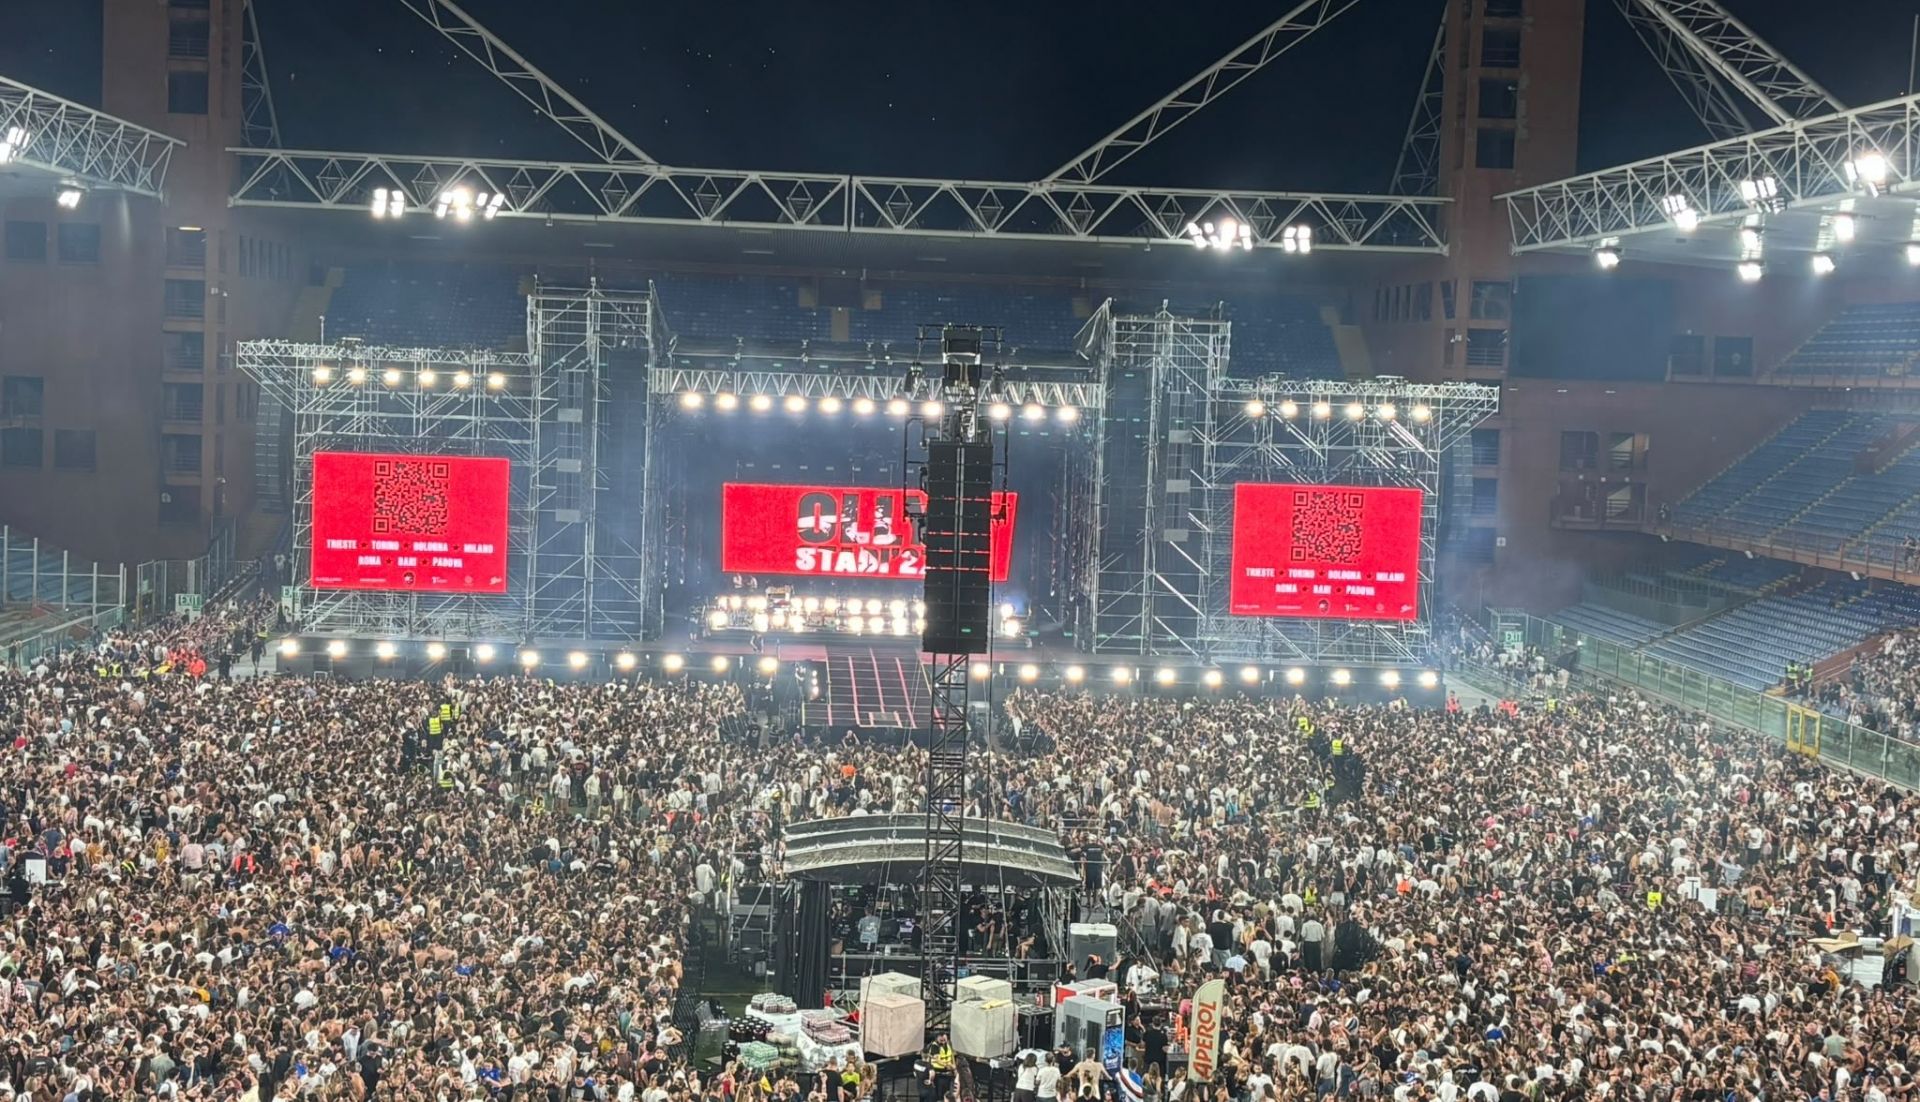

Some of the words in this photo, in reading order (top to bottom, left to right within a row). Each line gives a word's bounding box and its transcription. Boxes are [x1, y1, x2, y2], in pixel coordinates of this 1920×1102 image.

[327, 539, 357, 549] TRIESTE
[372, 540, 400, 551] TORINO
[358, 555, 381, 565] ROMA
[432, 557, 463, 568] PADOVA
[1246, 567, 1275, 577] TRIESTE
[180, 594, 201, 607] EXIT
[1505, 631, 1523, 642] EXIT
[1192, 1001, 1217, 1081] APEROL
